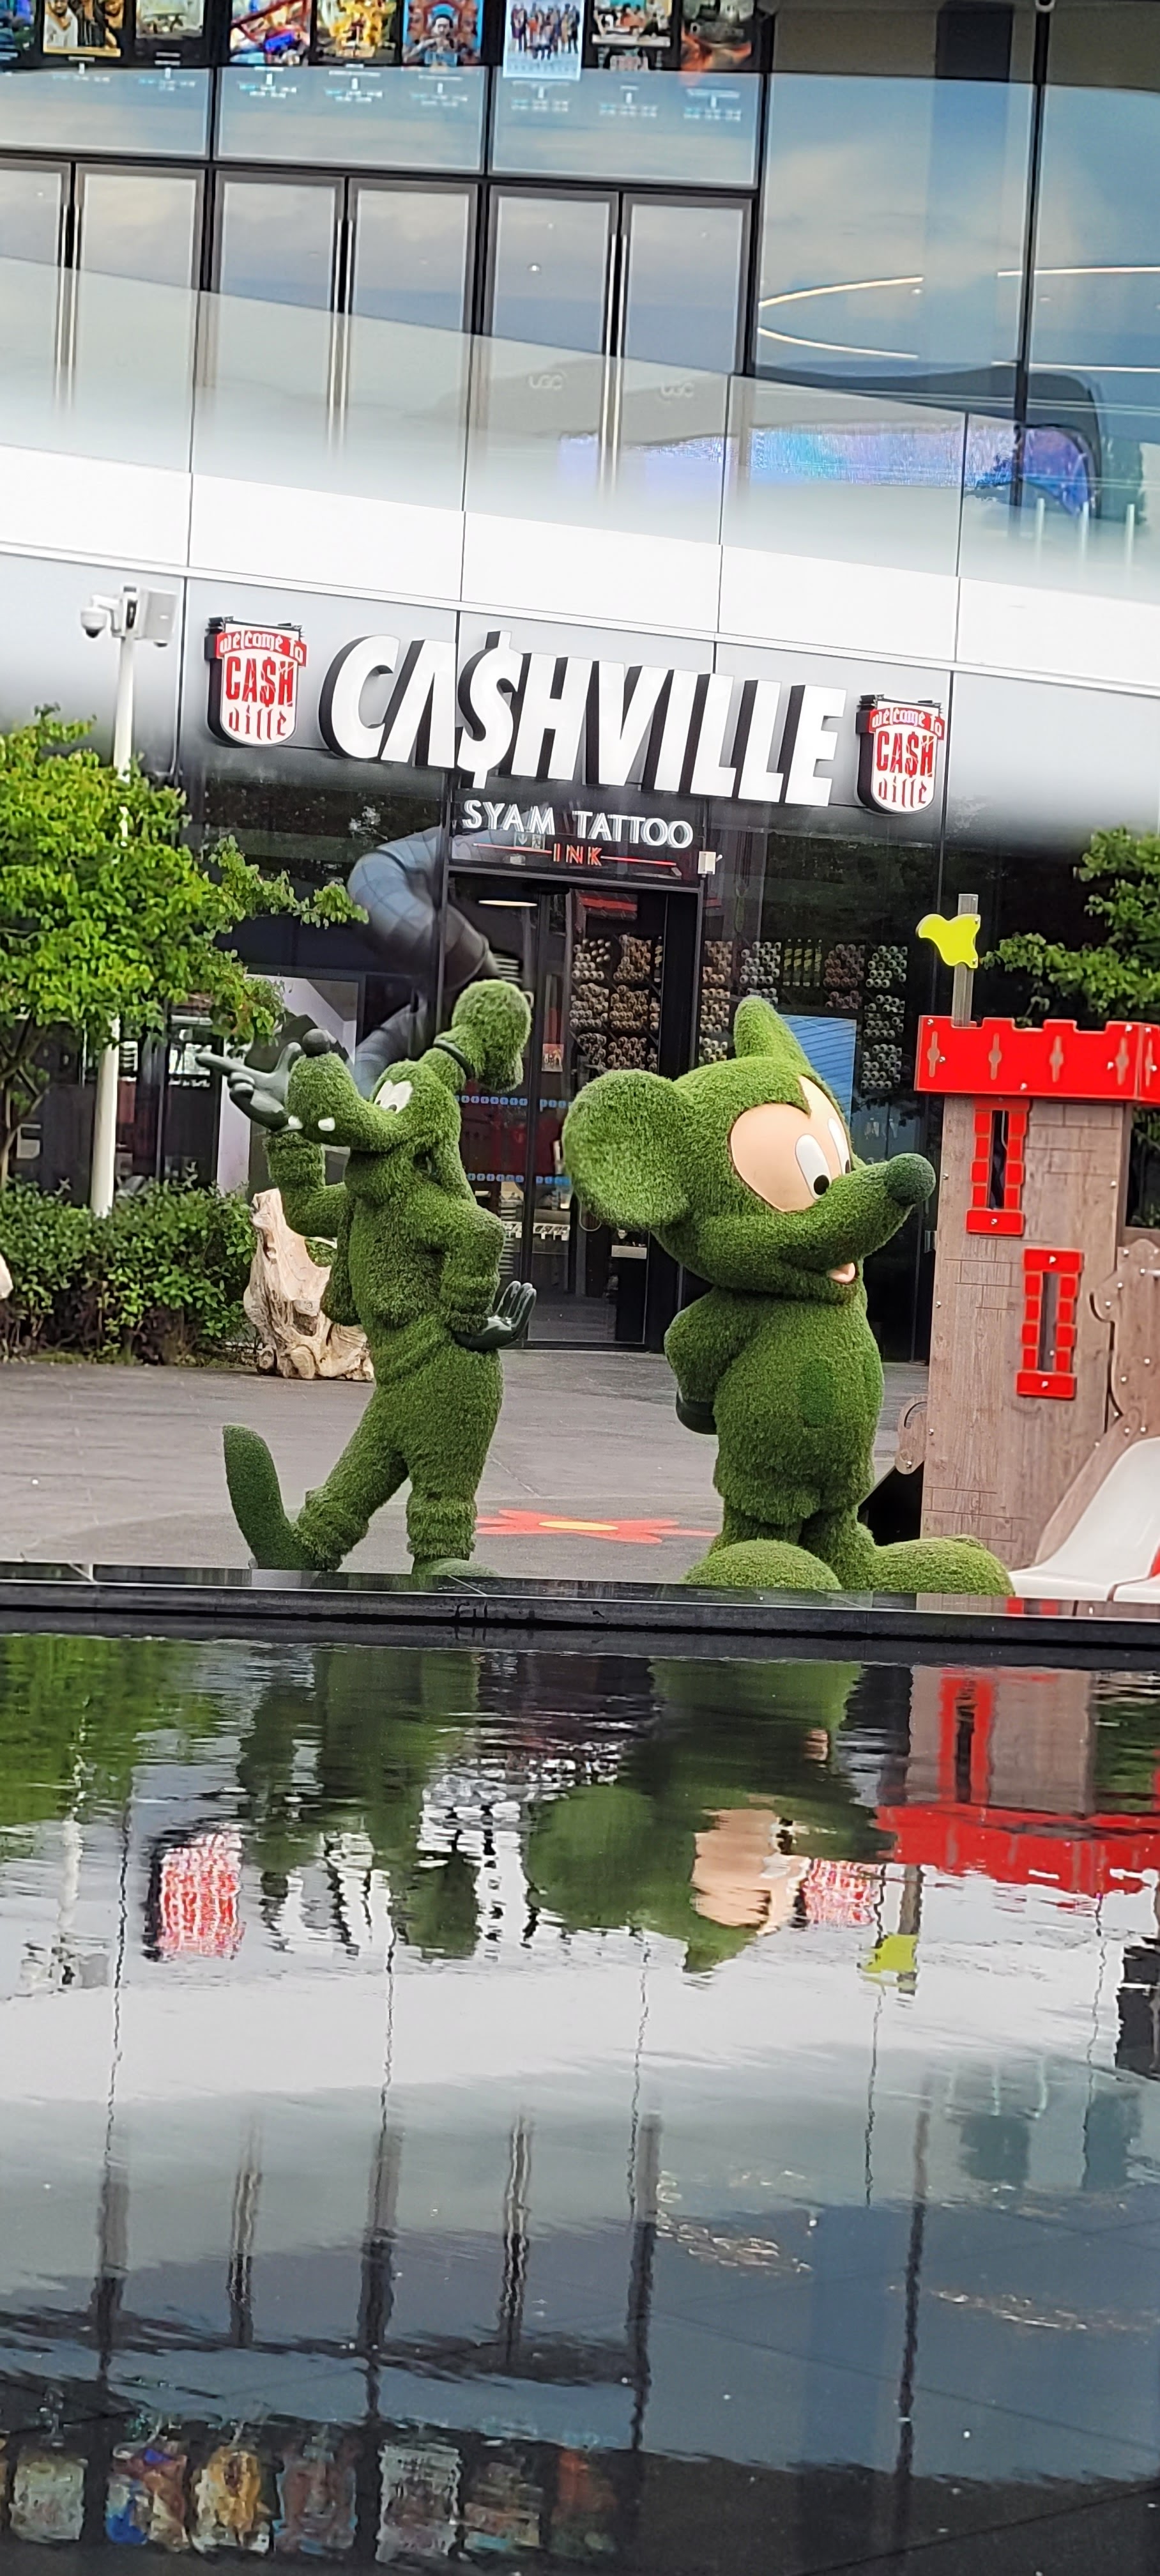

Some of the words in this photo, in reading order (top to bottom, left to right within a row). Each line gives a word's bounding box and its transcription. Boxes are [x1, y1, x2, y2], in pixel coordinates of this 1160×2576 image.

[220, 629, 283, 653] welcome
[225, 656, 294, 707] CA$H
[872, 707, 926, 728] welcome
[876, 731, 934, 778] CA$H
[462, 799, 555, 835] SYAM
[572, 810, 693, 848] TATTOO
[553, 843, 602, 866] INK
